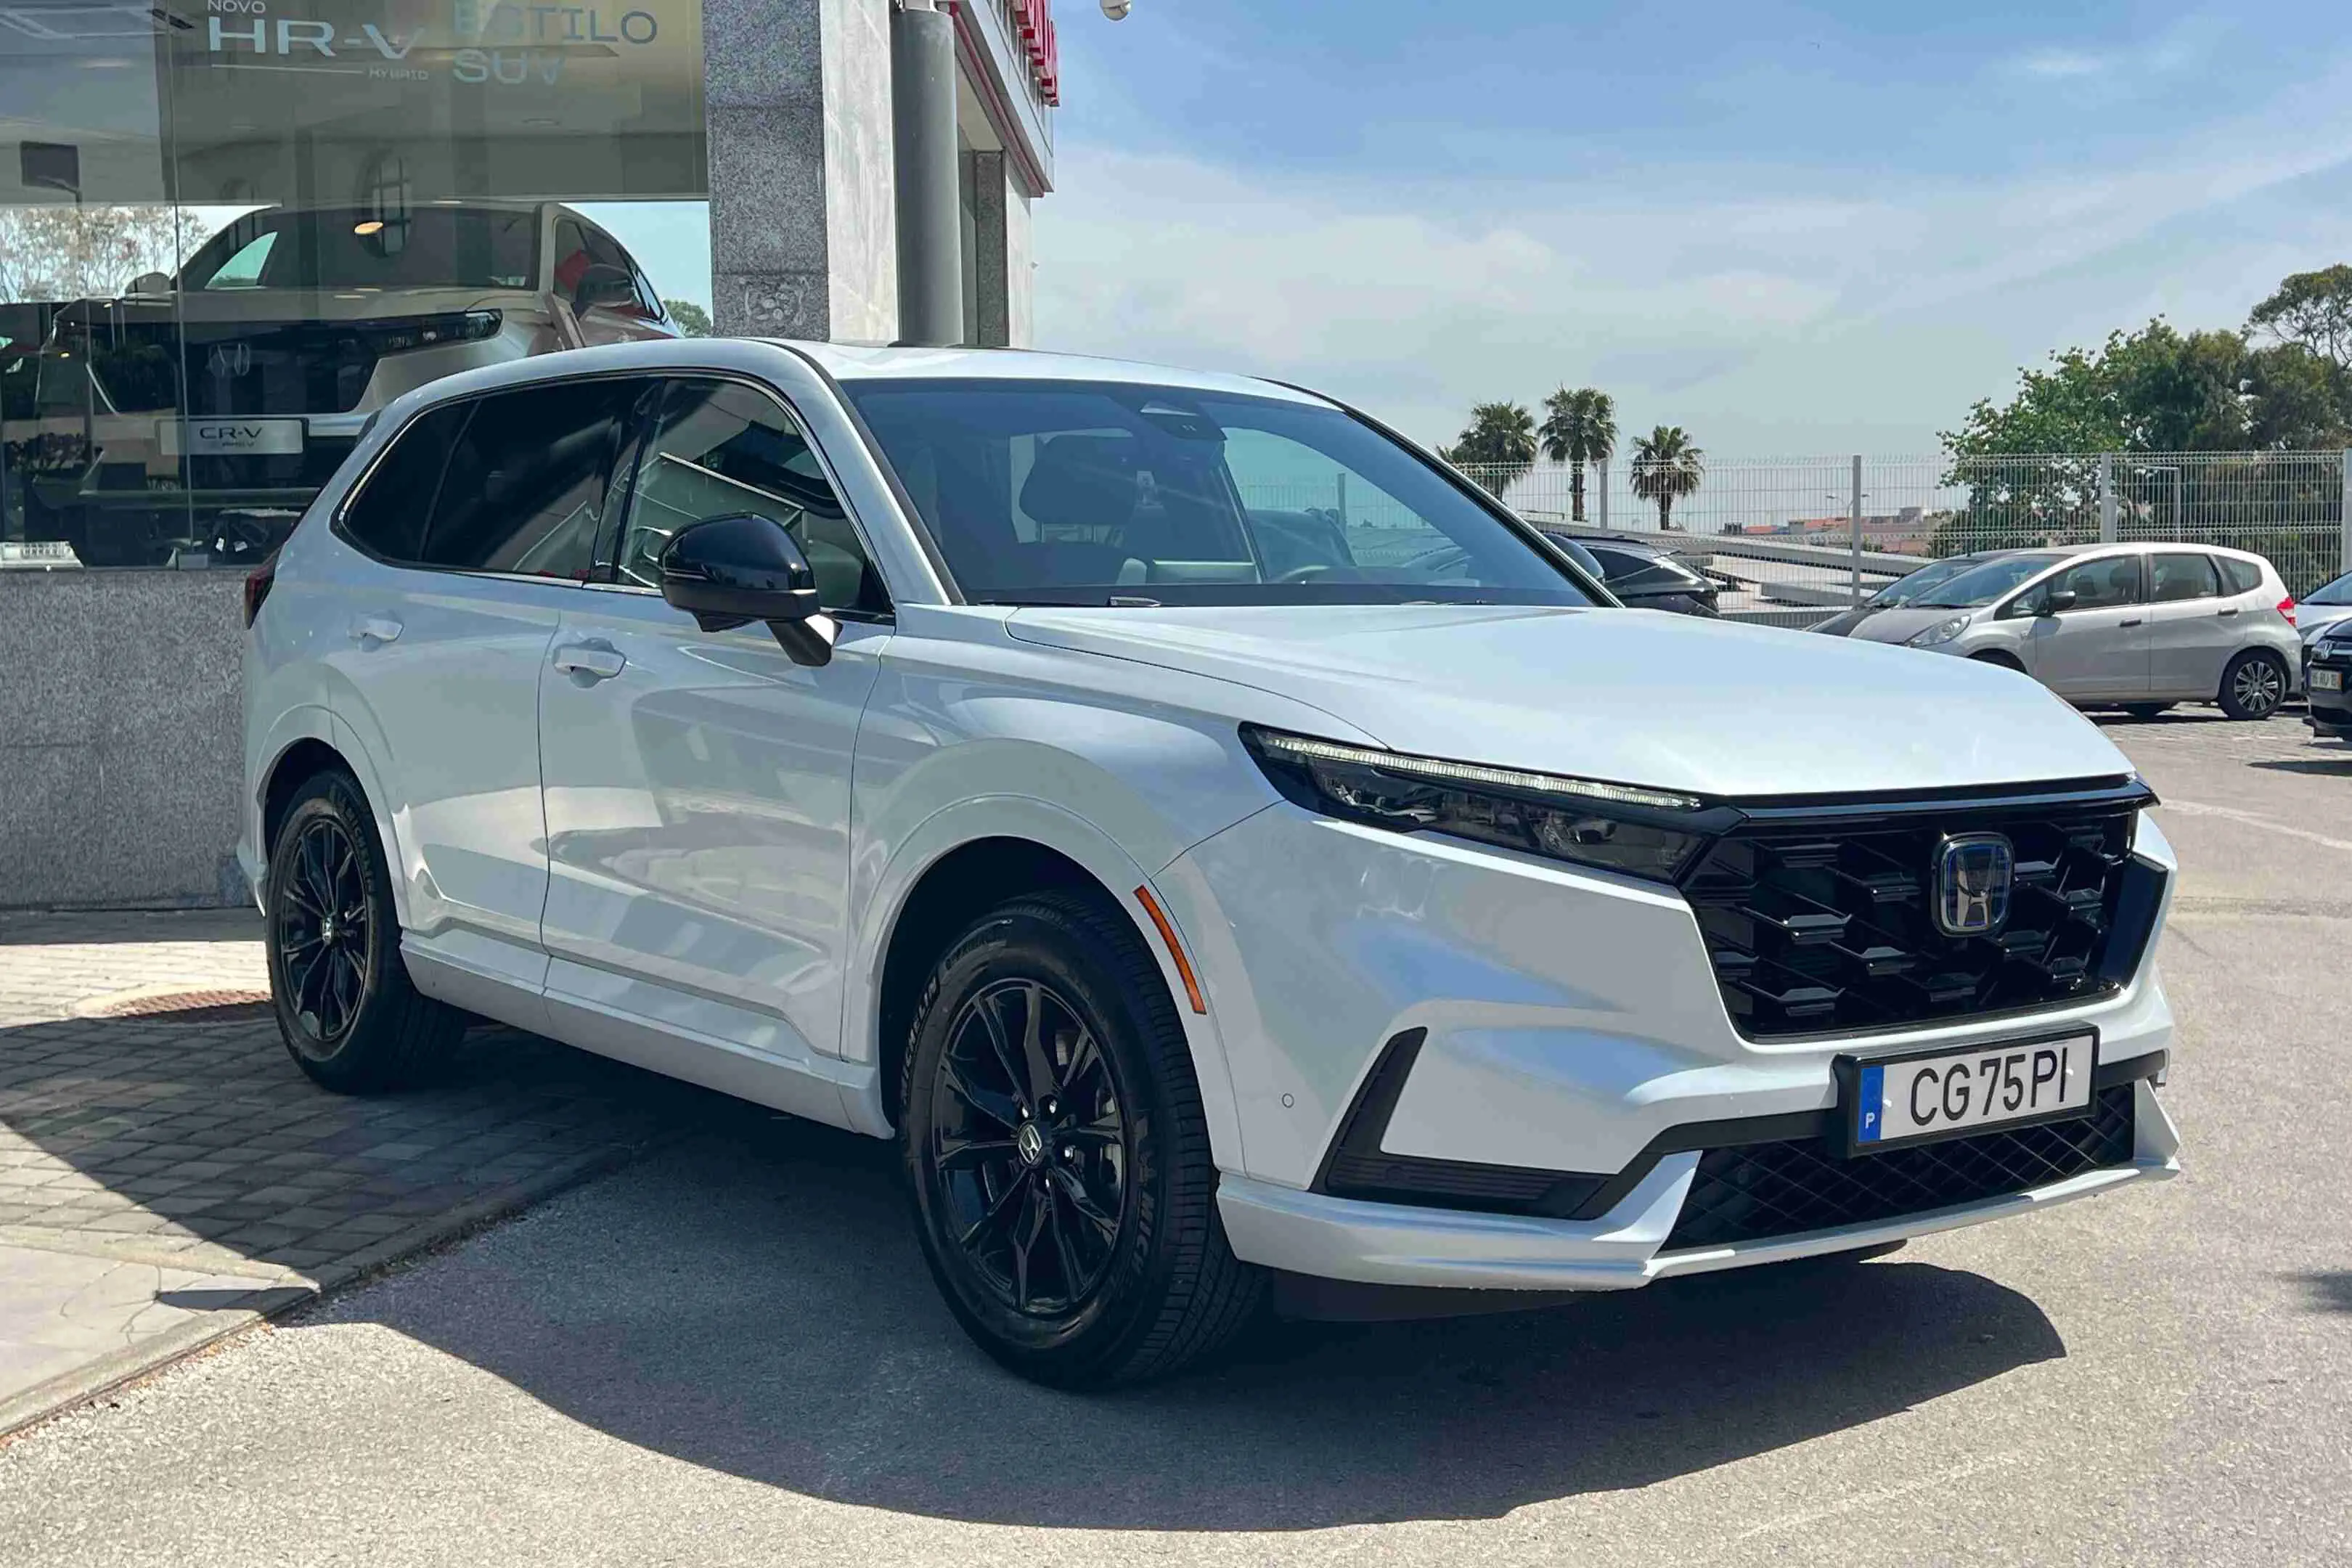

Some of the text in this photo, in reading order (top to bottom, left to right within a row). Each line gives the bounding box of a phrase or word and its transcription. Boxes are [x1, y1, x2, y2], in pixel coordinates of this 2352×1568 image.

[208, 0, 266, 13] NOVO
[208, 16, 425, 60] HR-V
[452, 48, 565, 86] SUV
[199, 426, 264, 440] CR-V
[1911, 1047, 2068, 1127] CG75PI
[1864, 1112, 1876, 1130] P
